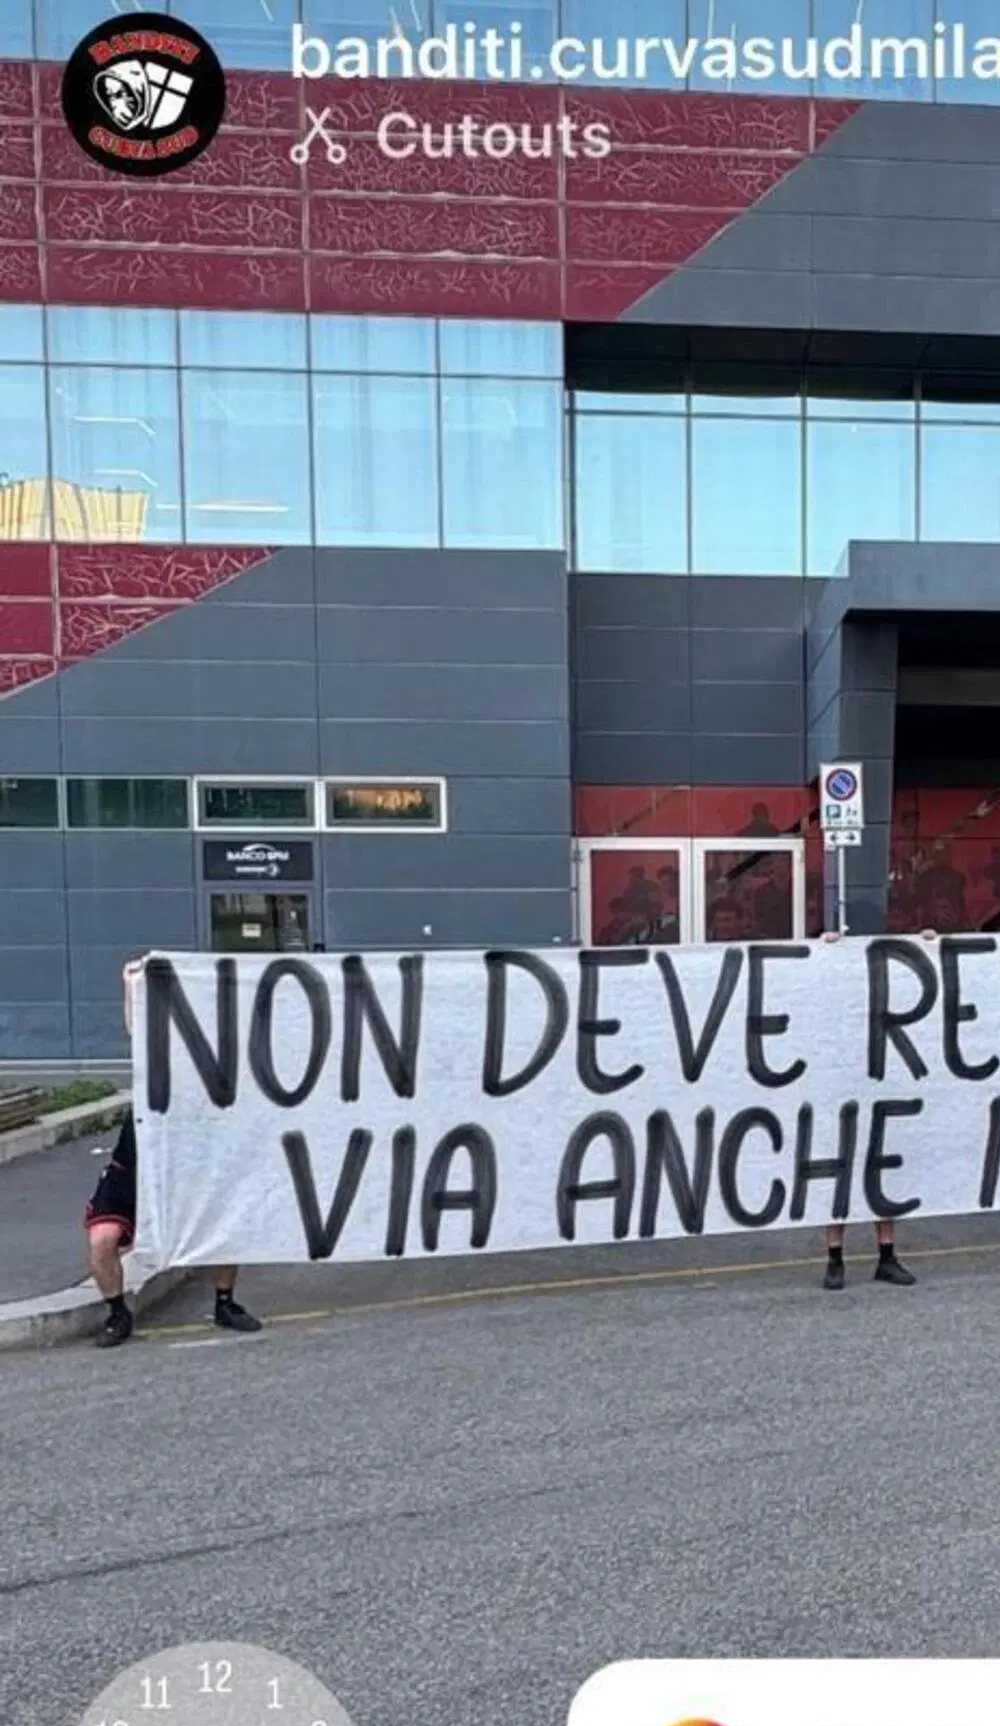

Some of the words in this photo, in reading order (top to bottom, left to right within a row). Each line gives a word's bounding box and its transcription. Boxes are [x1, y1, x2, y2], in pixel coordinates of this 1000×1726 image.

[145, 955, 424, 1113] NON
[481, 944, 812, 1097] DEVE
[281, 1122, 497, 1260] VIA
[556, 1099, 923, 1241] ANCHE
